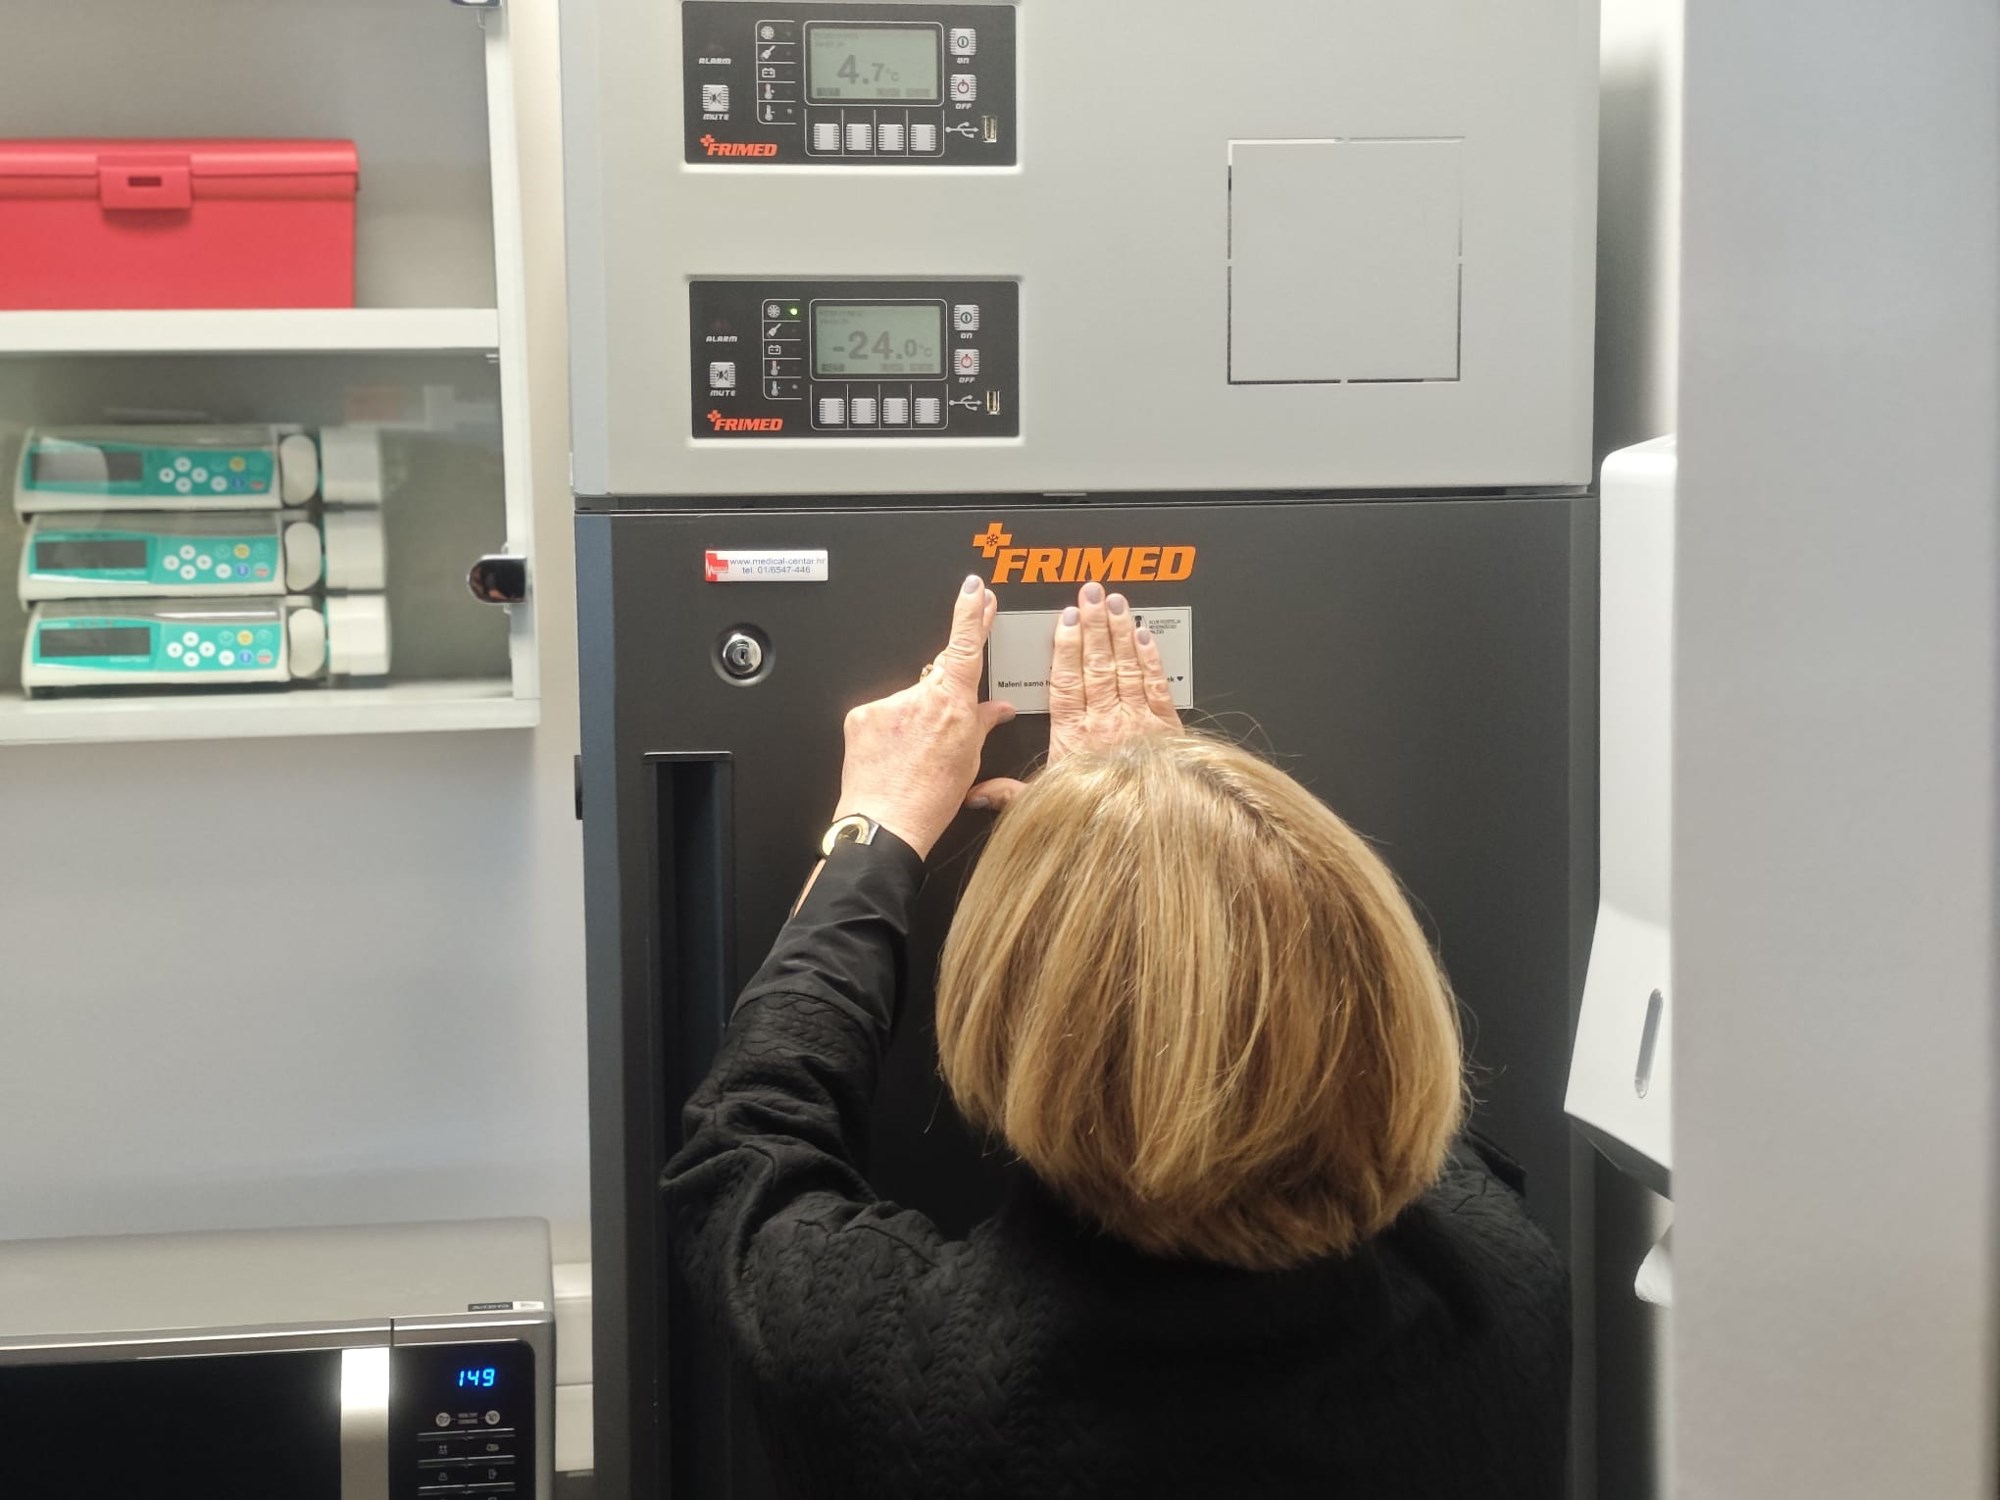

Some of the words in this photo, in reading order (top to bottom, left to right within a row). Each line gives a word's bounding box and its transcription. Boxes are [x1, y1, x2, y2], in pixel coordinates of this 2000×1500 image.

[698, 57, 732, 65] ALARM
[702, 113, 730, 121] MUTE
[707, 143, 778, 157] FRIMED
[705, 335, 738, 343] ALARM
[710, 389, 736, 397] MUTE
[713, 418, 783, 431] FRIMED
[991, 546, 1196, 584] FRIMED
[1024, 680, 1043, 688] samo
